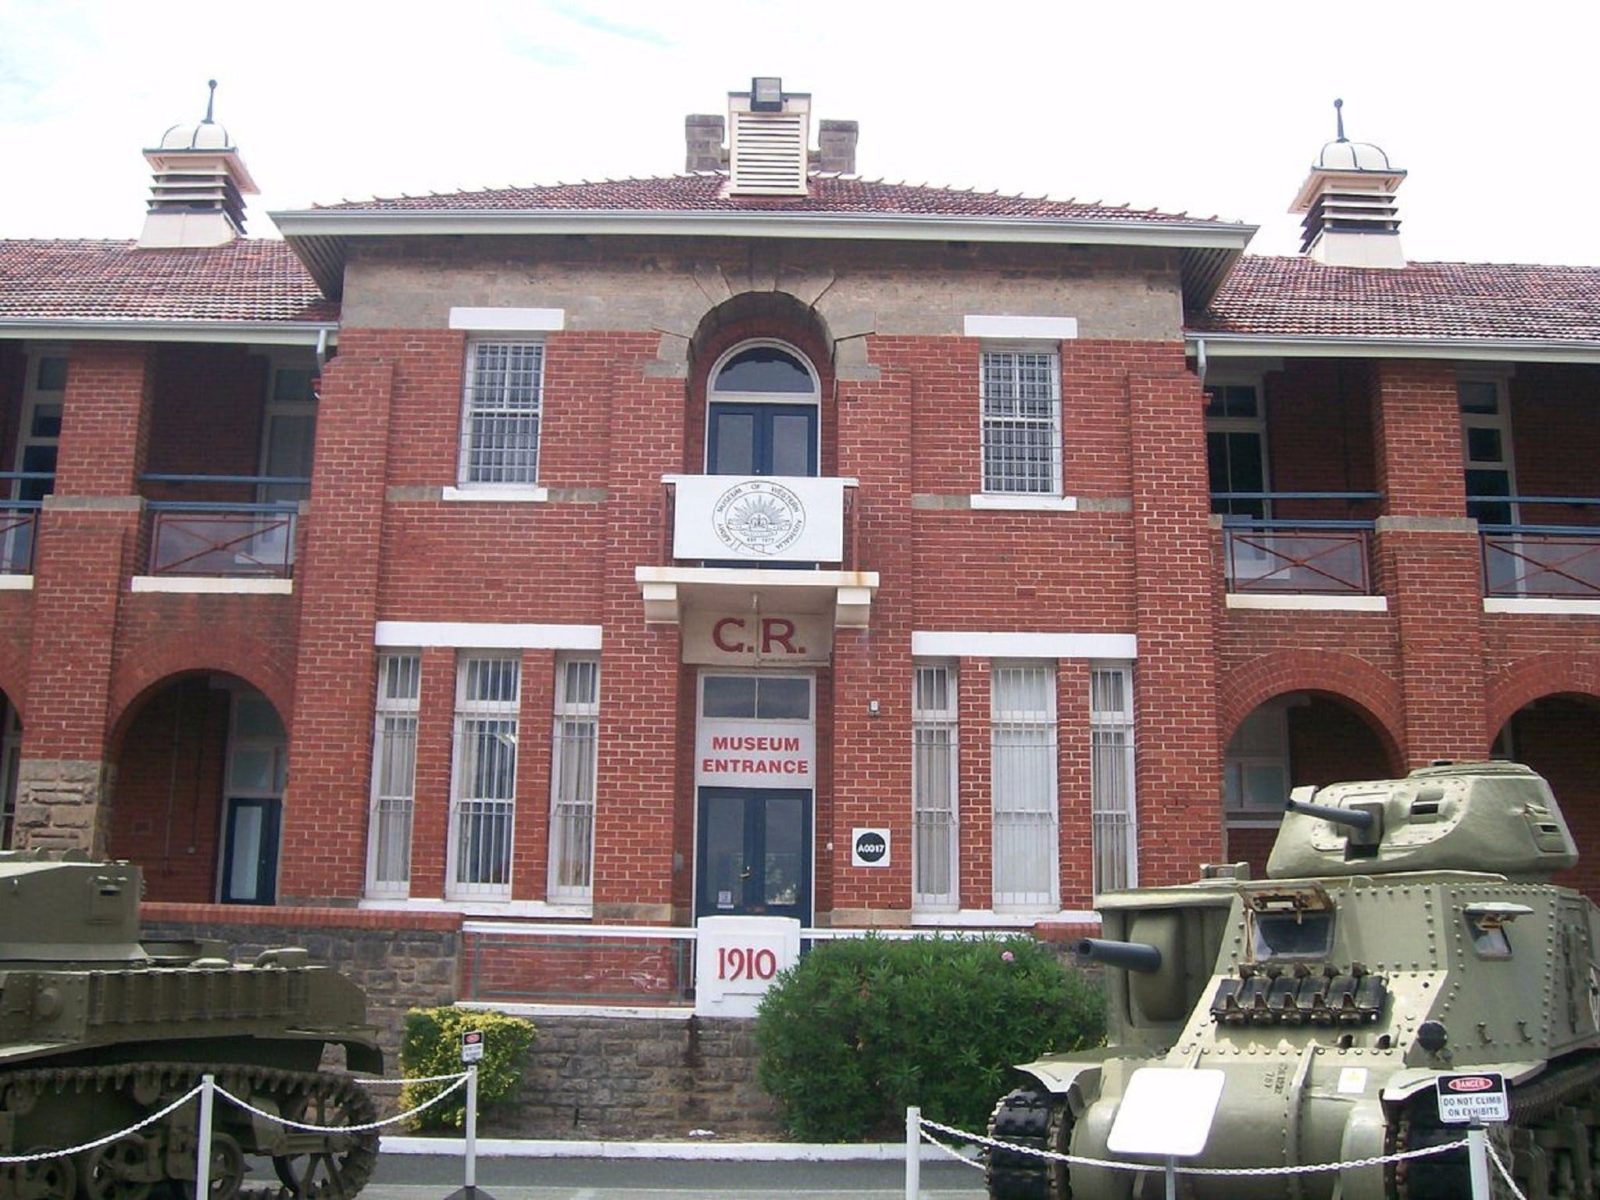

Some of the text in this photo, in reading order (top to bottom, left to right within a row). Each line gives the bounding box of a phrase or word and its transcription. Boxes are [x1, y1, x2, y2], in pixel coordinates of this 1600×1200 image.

[716, 487, 743, 513] MUSEUM
[771, 486, 800, 513] WESTERN
[775, 519, 803, 550] AUSTRALIA
[712, 736, 800, 752] MUSEUM
[702, 758, 809, 774] ENTRANCE
[718, 947, 777, 982] 1910
[1455, 1079, 1486, 1089] DANGER
[1443, 1096, 1502, 1106] DO NOT CLIMB
[1462, 1107, 1499, 1116] EXHIBITS
